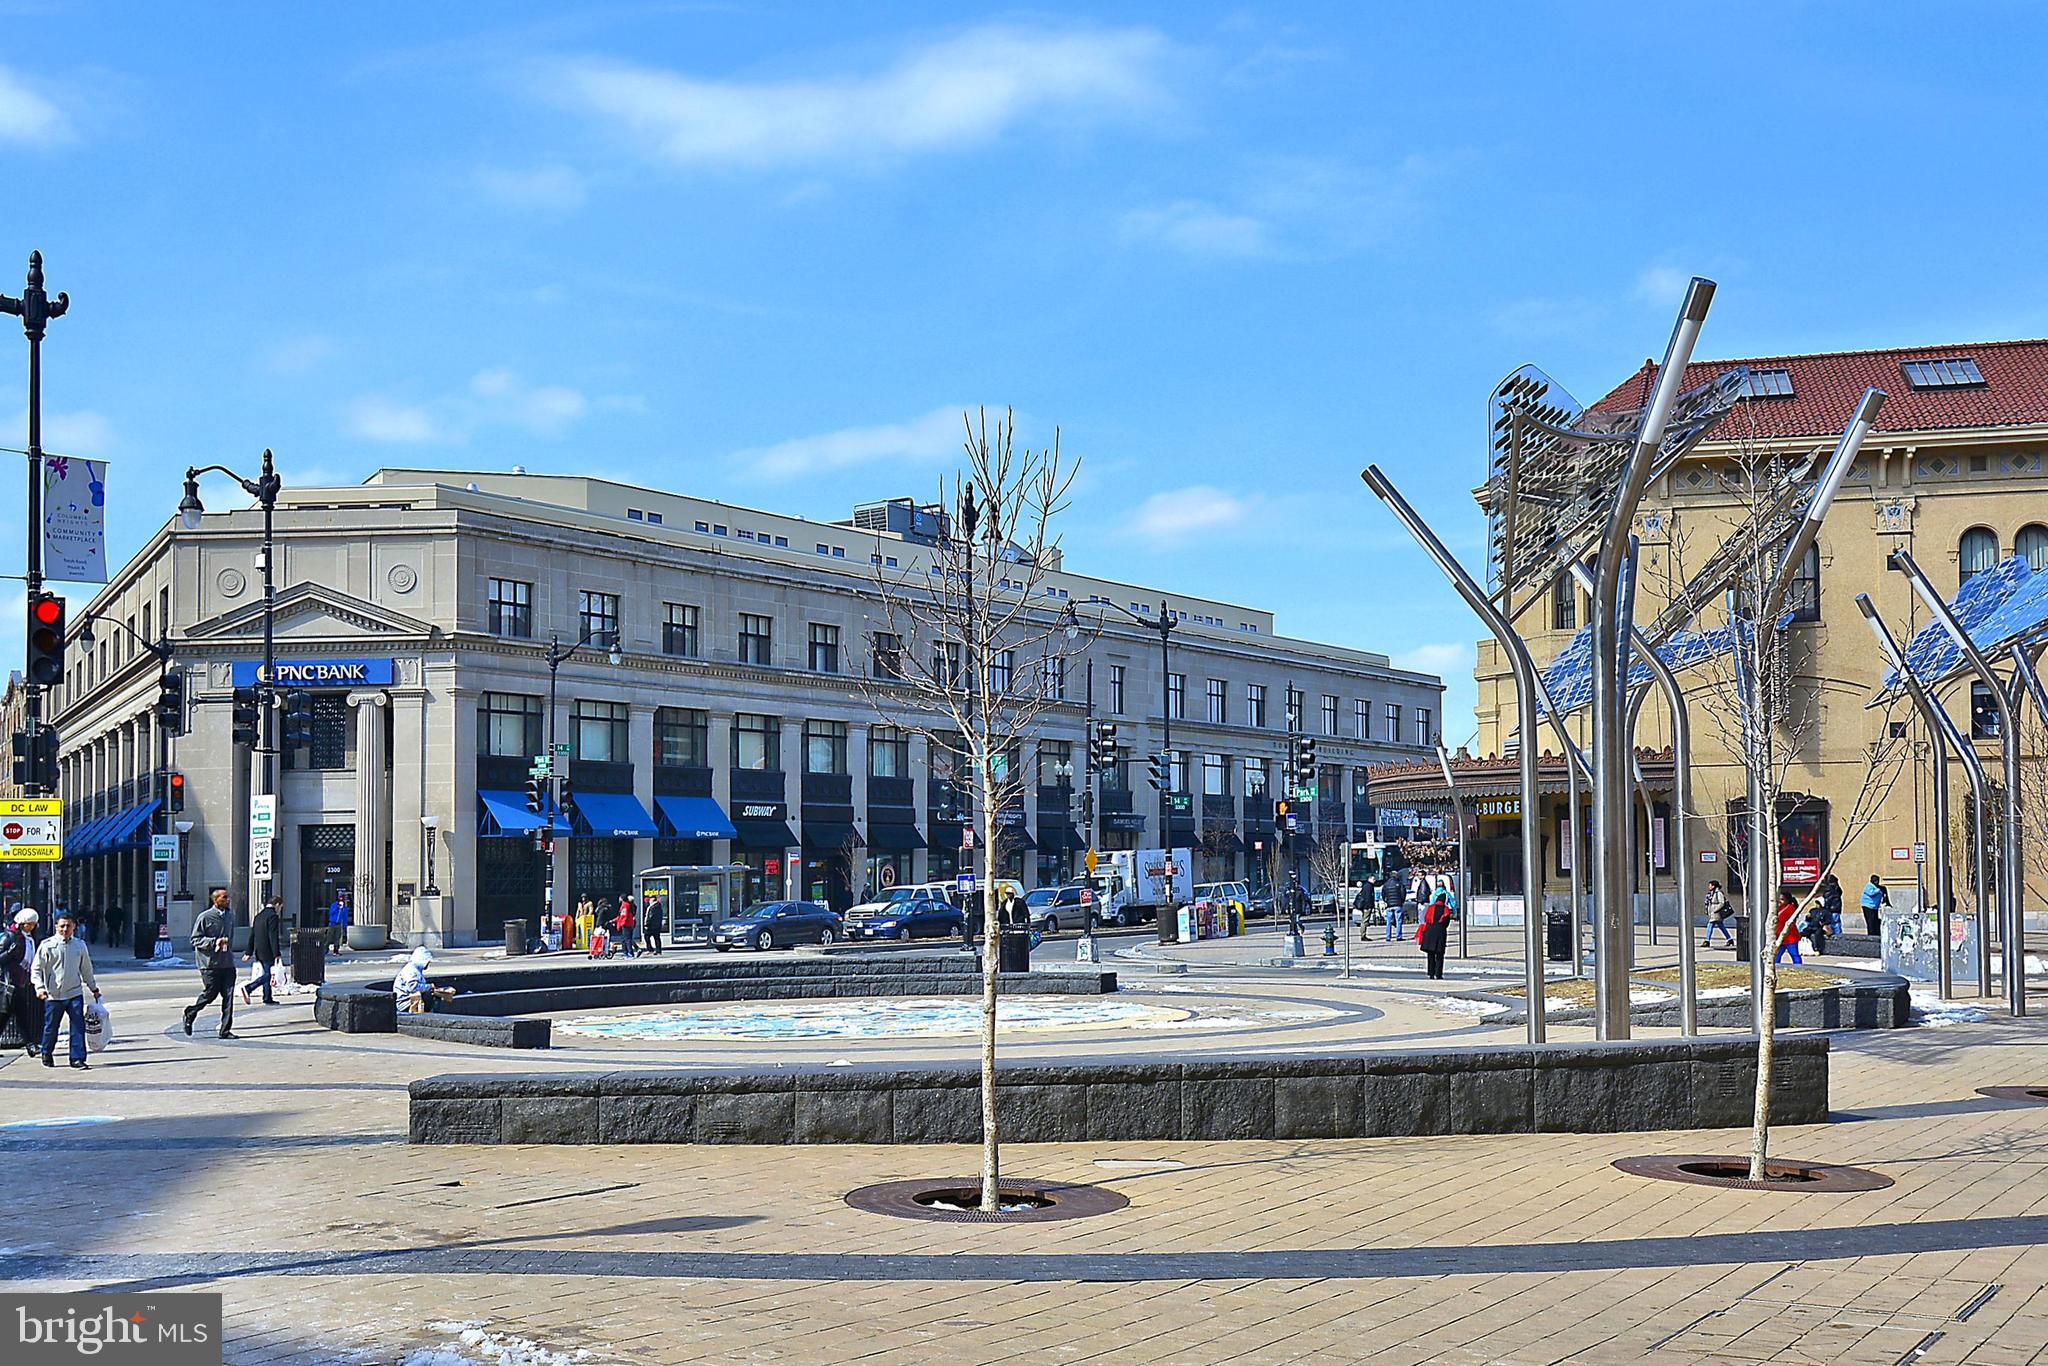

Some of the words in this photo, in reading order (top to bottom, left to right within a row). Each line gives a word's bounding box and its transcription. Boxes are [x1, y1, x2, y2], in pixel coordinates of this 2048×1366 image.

[57, 513, 87, 521] COLUMBIA
[53, 527, 96, 537] COMMUNITY
[53, 534, 96, 544] MARKETPLACE
[275, 664, 315, 681] PNC
[316, 664, 365, 680] BANK
[1318, 746, 1355, 756] BUILDING
[11, 804, 25, 813] DC
[29, 804, 48, 812] LAW
[742, 805, 777, 817] SUBWAY
[26, 827, 41, 836] FOR
[12, 848, 55, 857] CROSSWALK
[254, 859, 270, 875] 25
